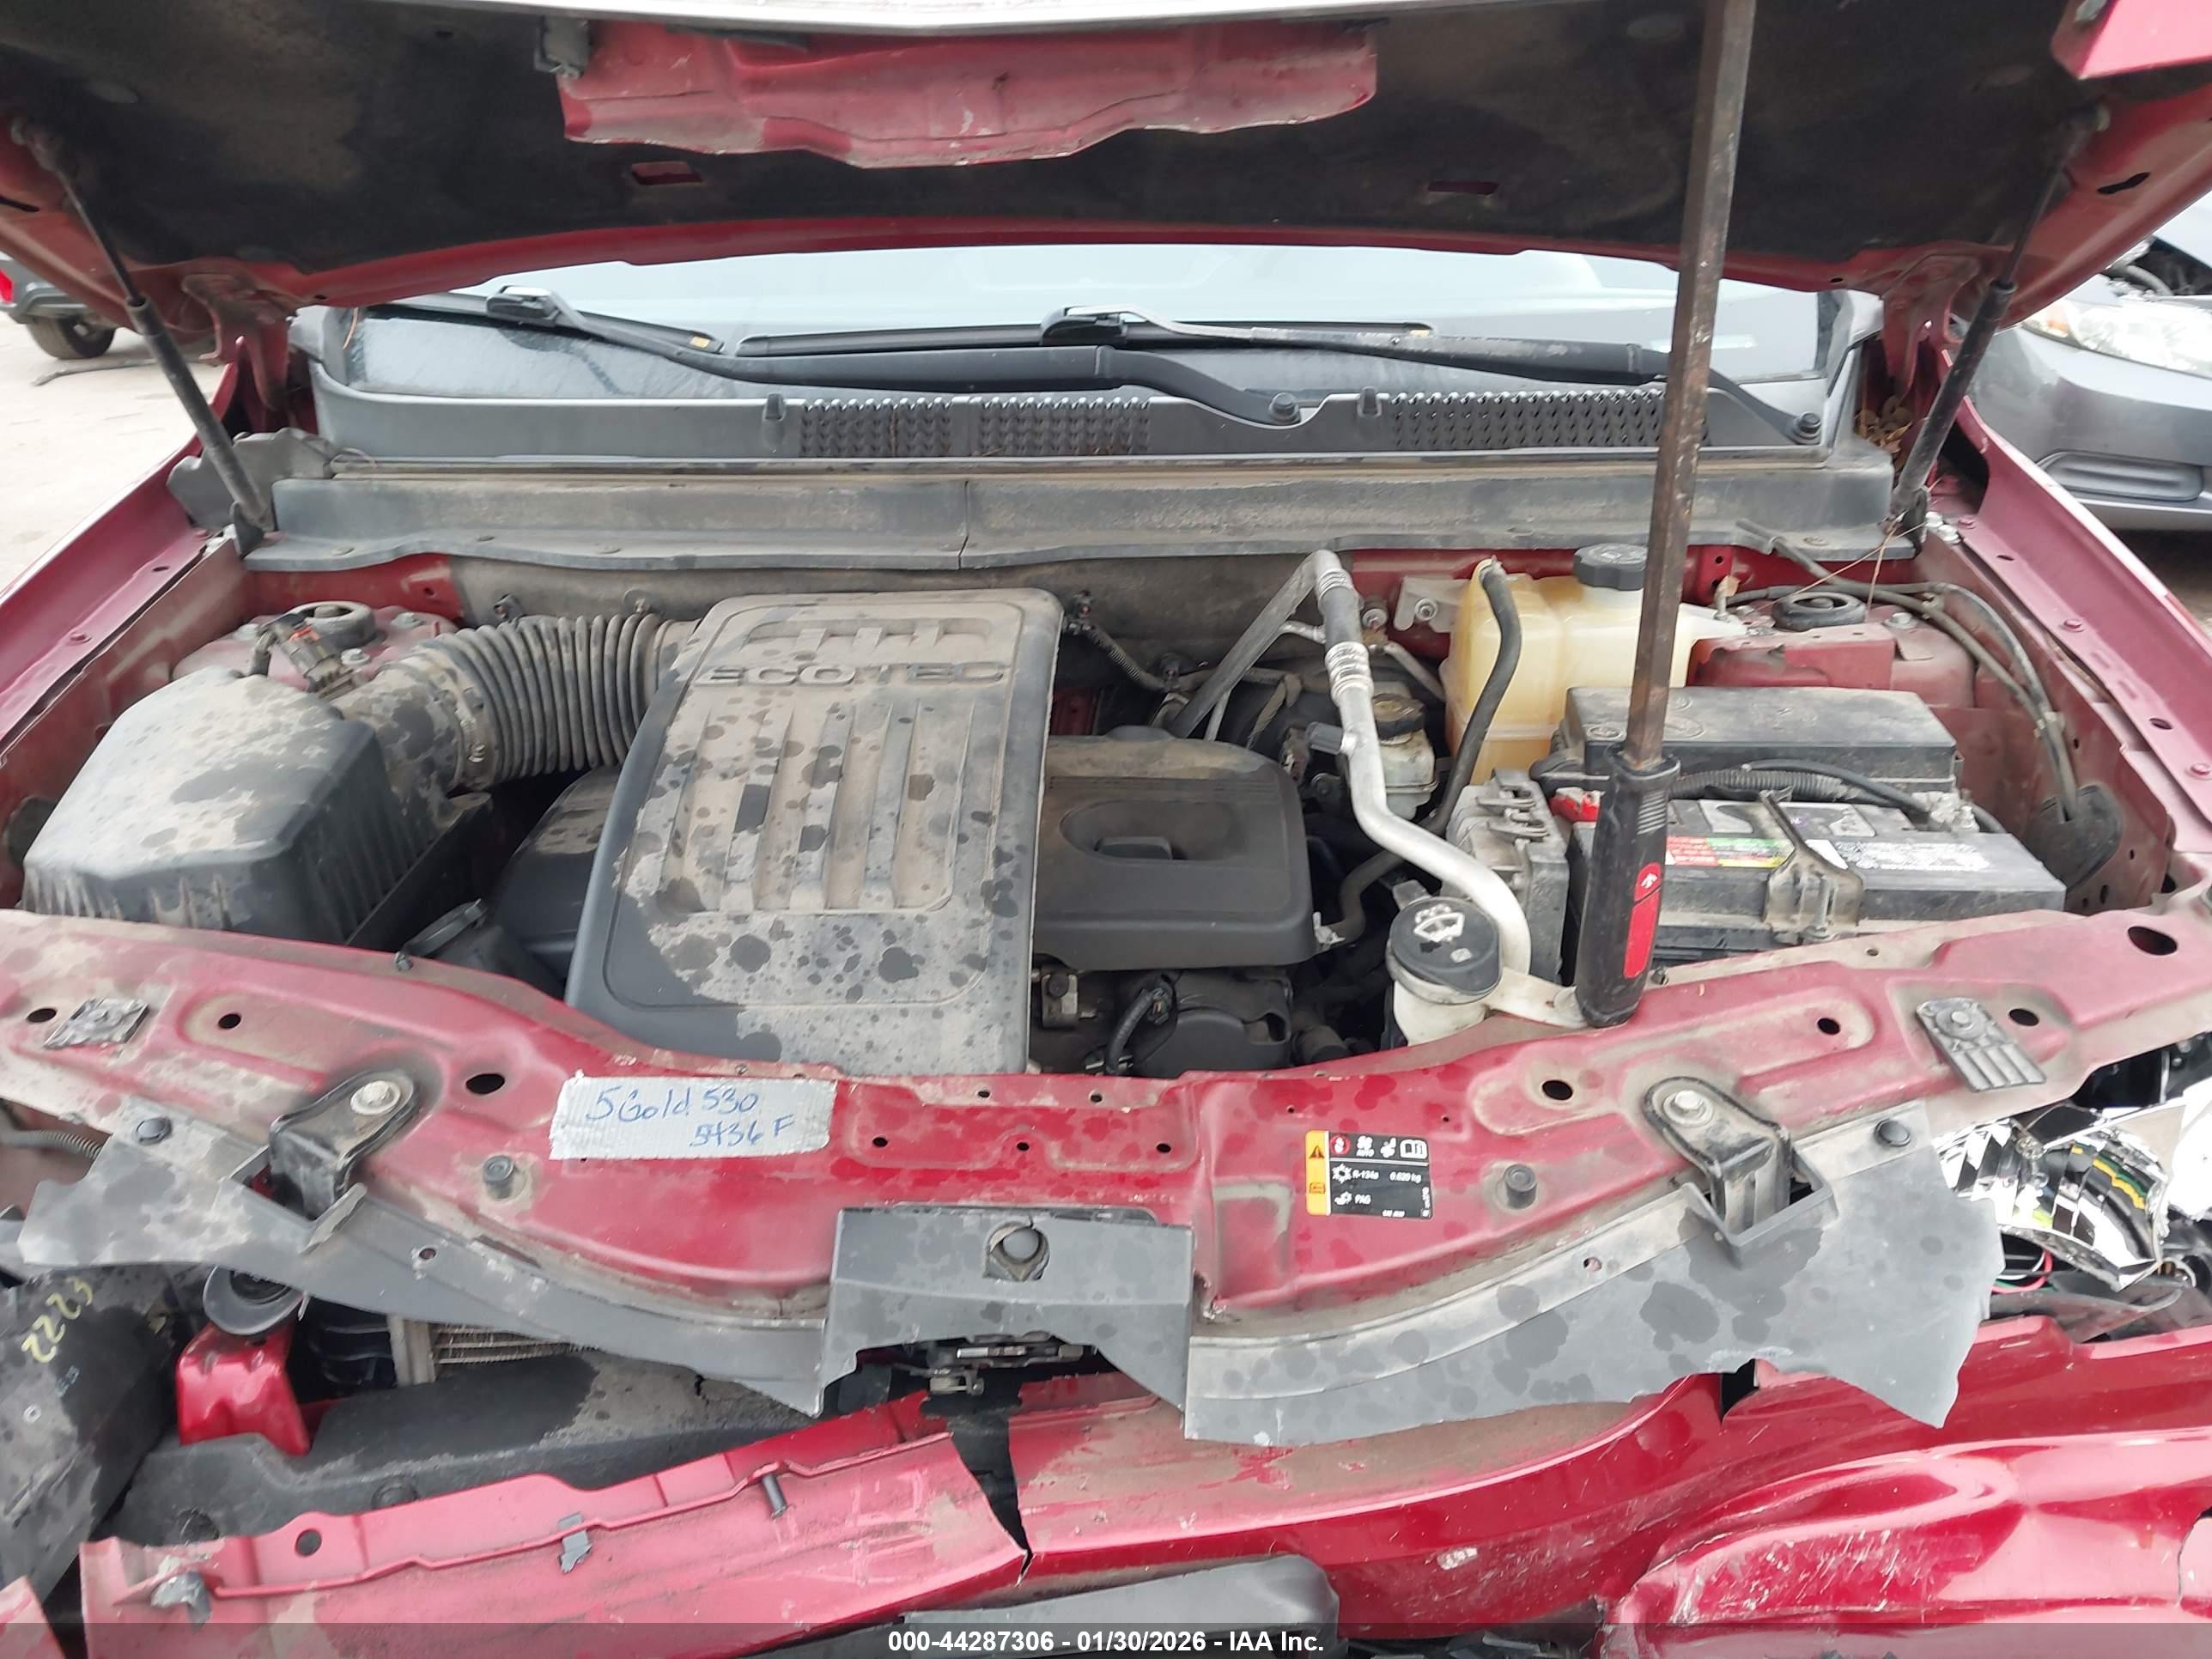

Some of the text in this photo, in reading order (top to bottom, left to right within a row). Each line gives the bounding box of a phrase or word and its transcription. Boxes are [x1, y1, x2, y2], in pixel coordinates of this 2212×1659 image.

[694, 662, 1012, 688] ECOTEC
[701, 1086, 759, 1115] 530
[773, 1113, 795, 1138] F
